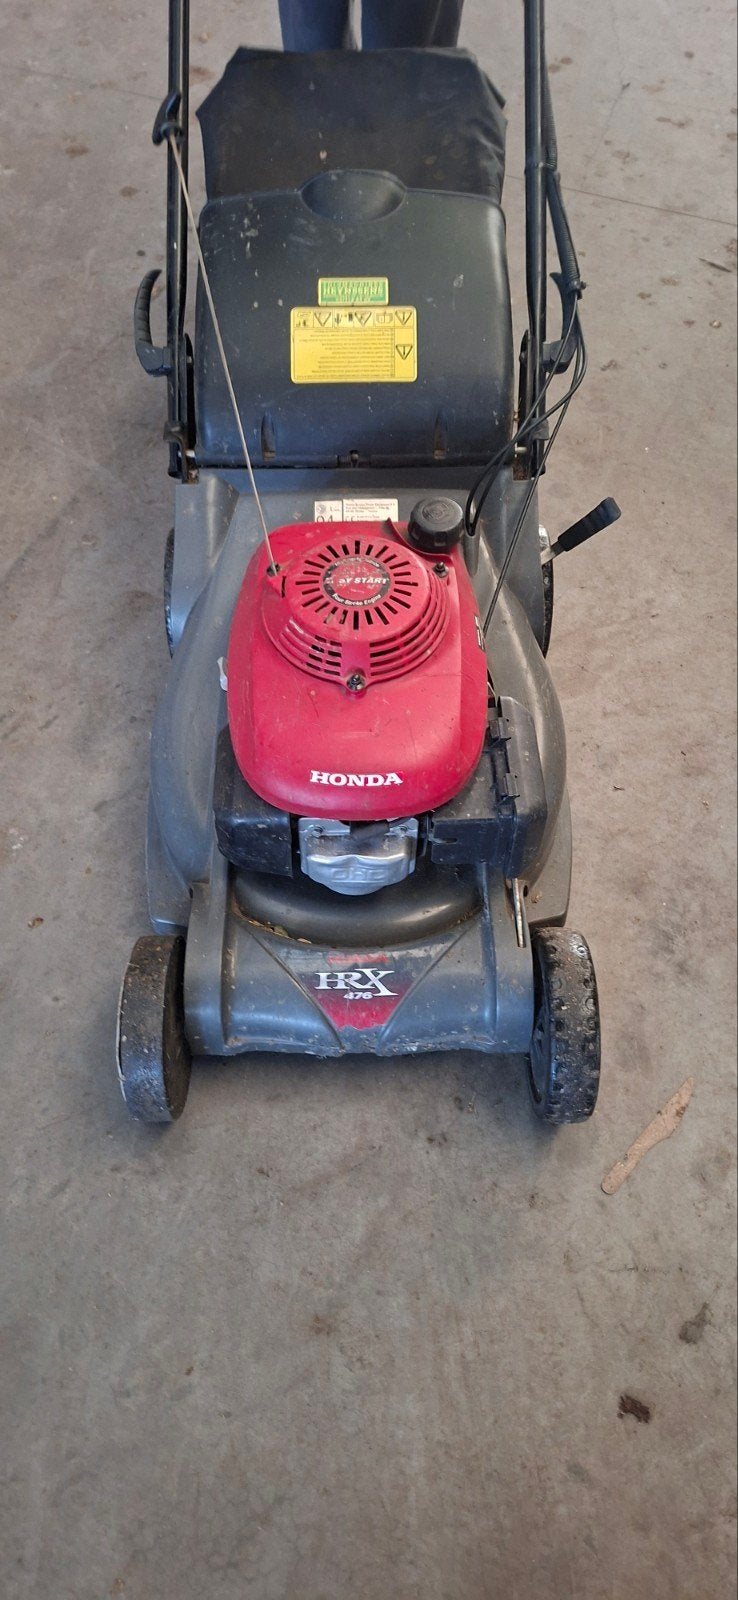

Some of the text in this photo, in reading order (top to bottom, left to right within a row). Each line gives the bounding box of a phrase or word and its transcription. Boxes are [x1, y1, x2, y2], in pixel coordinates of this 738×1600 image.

[354, 577, 389, 585] START
[310, 770, 404, 787] HONDA
[314, 967, 399, 997] HRX
[343, 991, 374, 1000] 476
